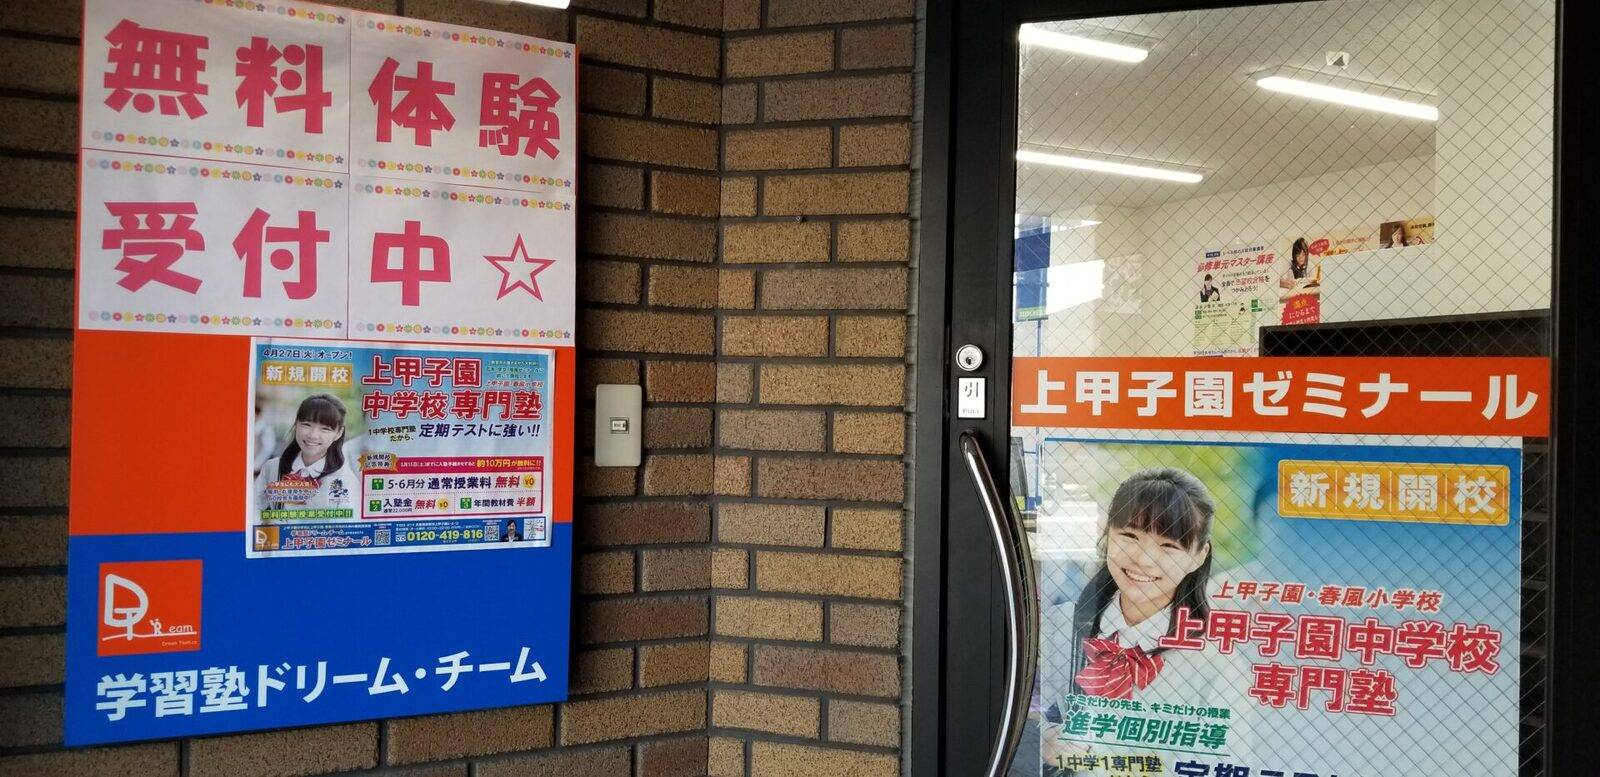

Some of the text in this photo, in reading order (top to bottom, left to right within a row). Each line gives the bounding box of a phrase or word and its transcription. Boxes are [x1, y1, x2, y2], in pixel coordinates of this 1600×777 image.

[265, 365, 349, 383] 新規開校
[362, 355, 481, 387] 上甲子園
[362, 390, 543, 420] 中学校専門塾
[1020, 369, 1537, 422] 上甲子園ゼミナール
[495, 475, 520, 488] 無料
[1289, 470, 1498, 516] 新規開校
[415, 500, 436, 510] 無料
[407, 529, 484, 541] 0120-419-816
[1212, 580, 1442, 611] 上甲子園・春風小学校
[1160, 608, 1502, 675] 上甲子園中学校
[96, 646, 547, 722] 学習塾ドリーム・チーム
[1249, 663, 1397, 717] 専門塾
[1062, 710, 1230, 750] 進学個別指導
